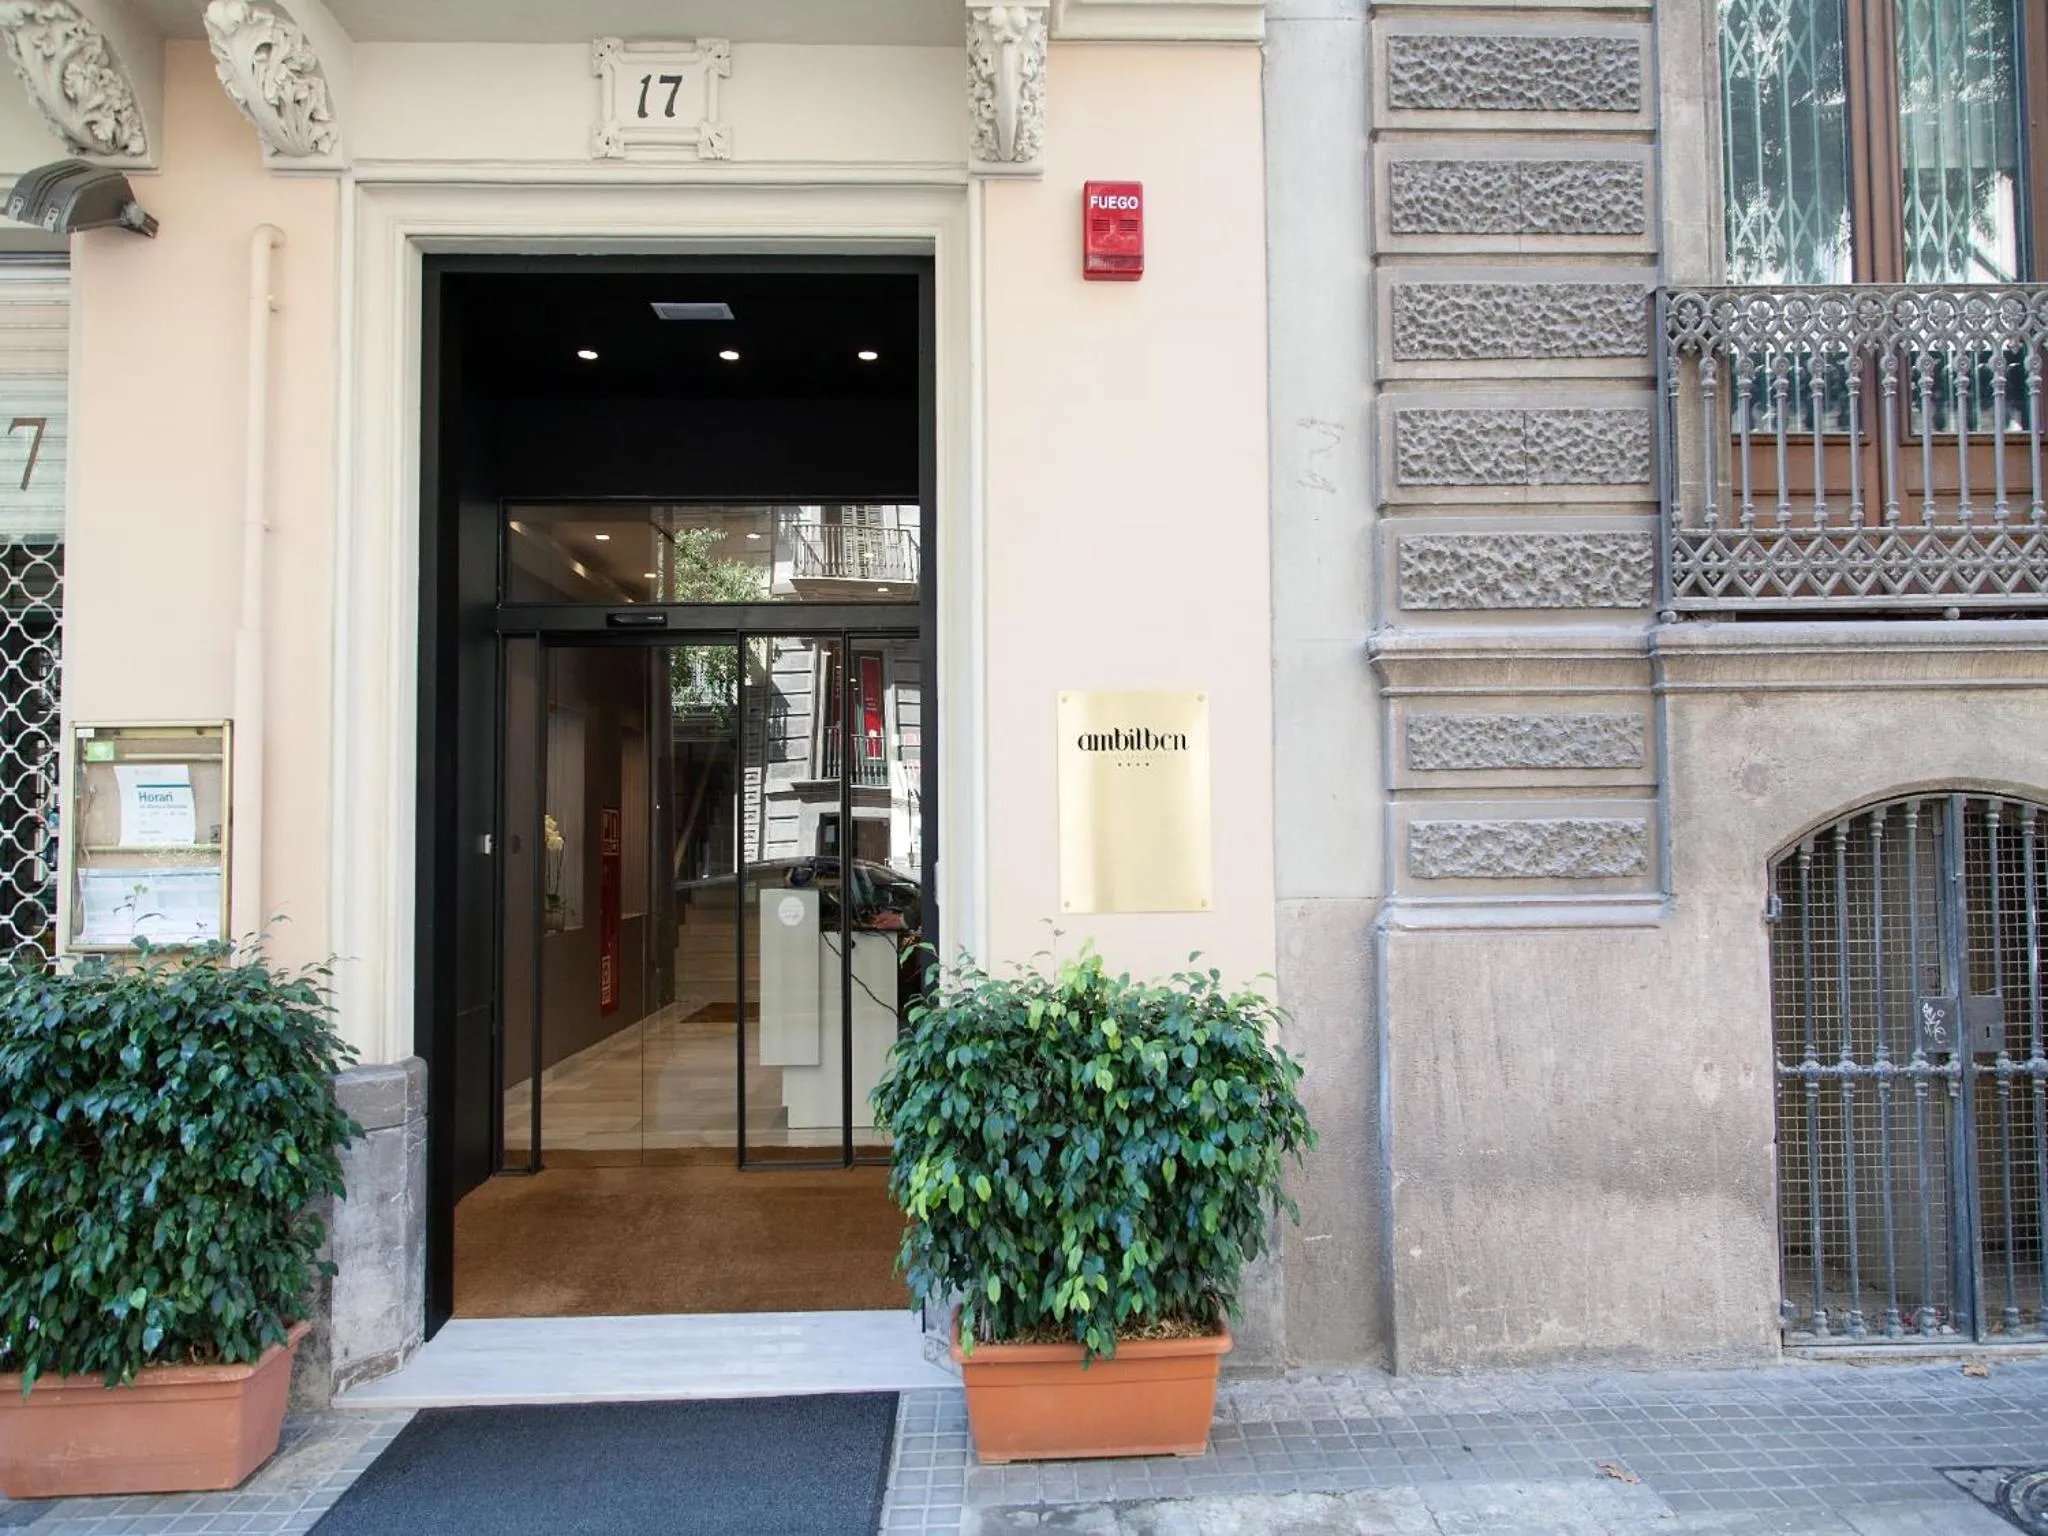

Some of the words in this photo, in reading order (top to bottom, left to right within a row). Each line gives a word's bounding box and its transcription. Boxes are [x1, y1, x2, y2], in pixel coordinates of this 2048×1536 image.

[637, 74, 683, 118] 17
[1090, 196, 1138, 209] FUEGO
[138, 791, 173, 802] Horari
